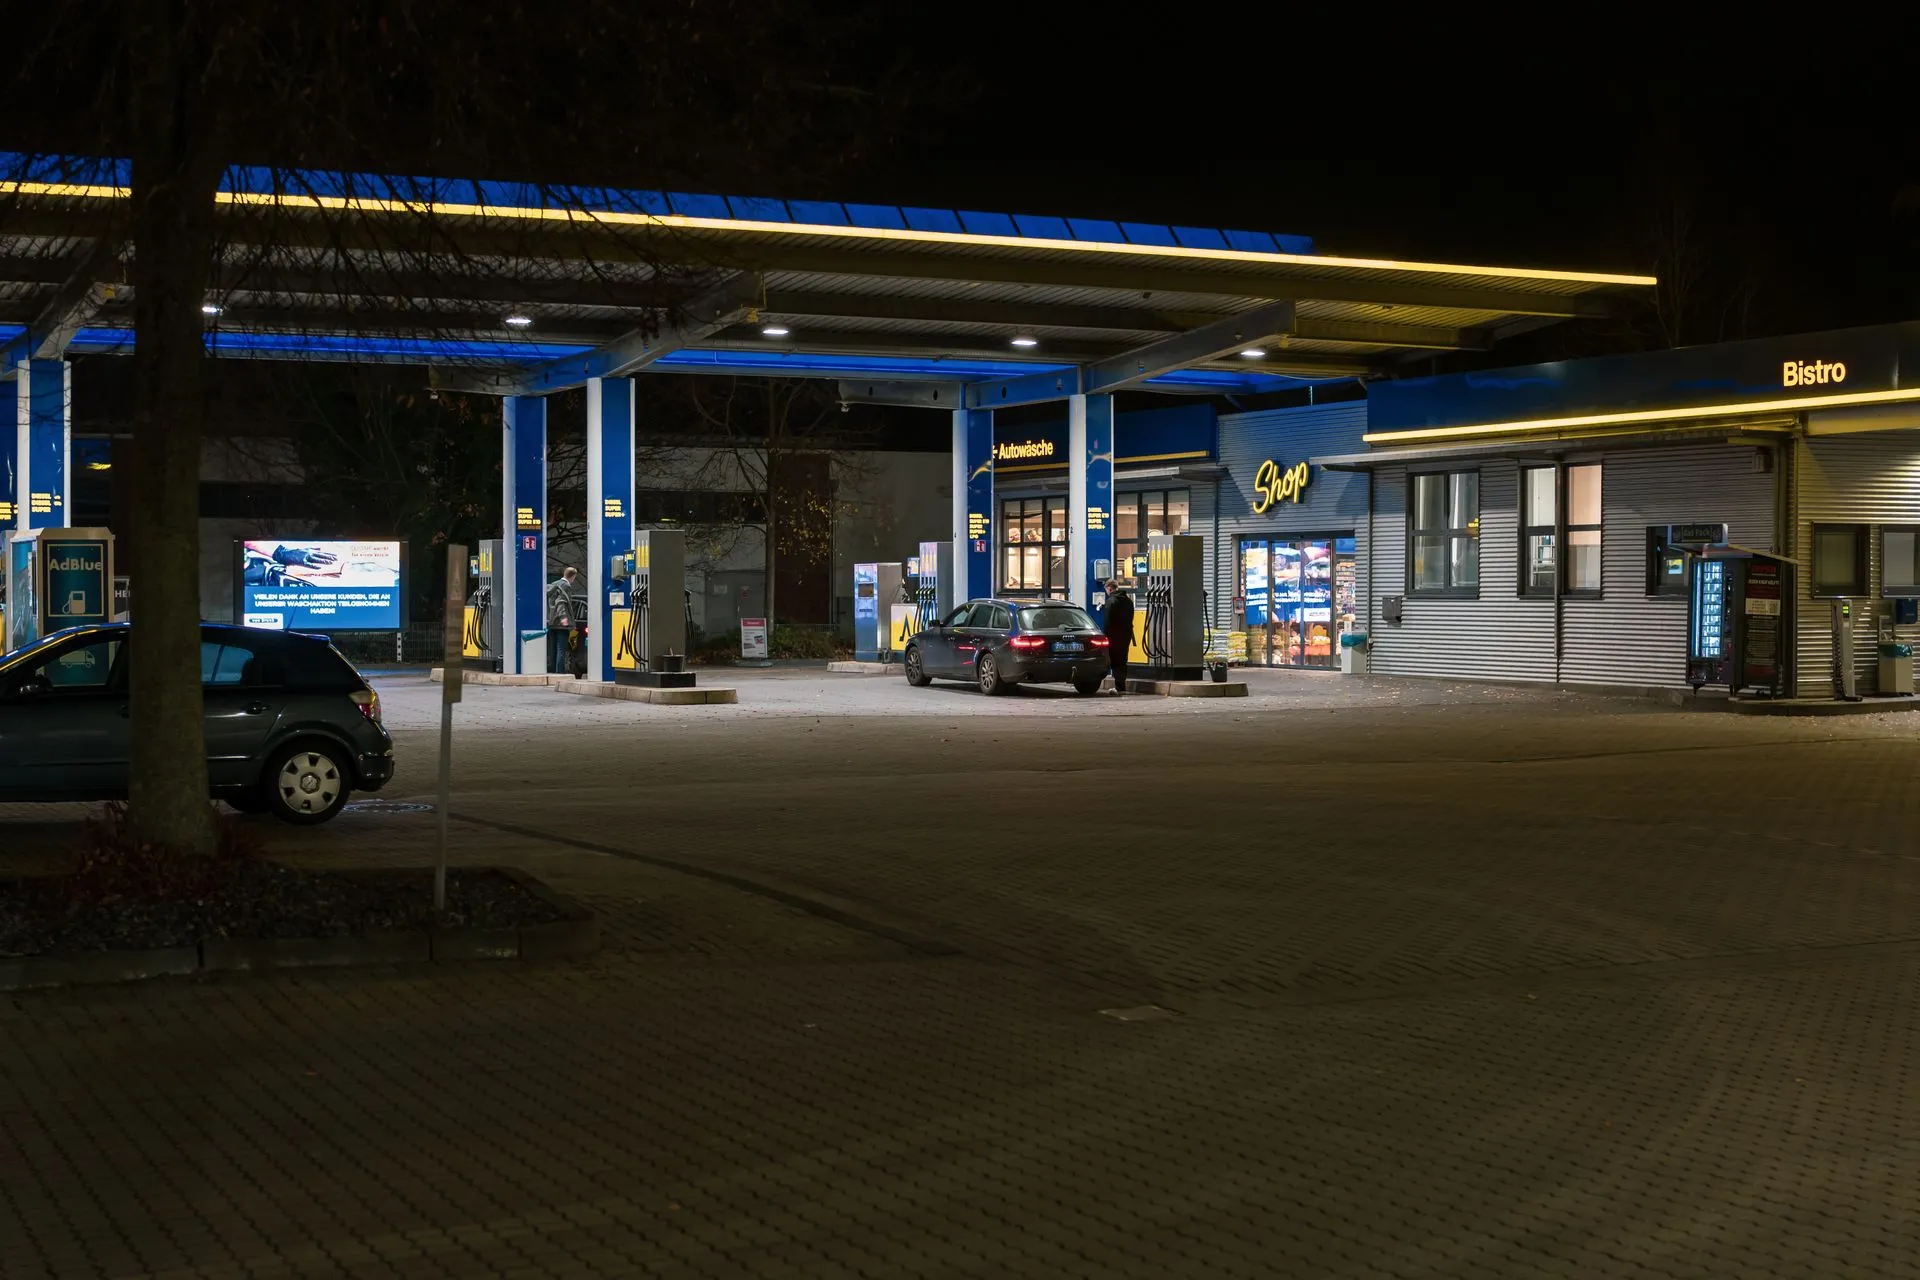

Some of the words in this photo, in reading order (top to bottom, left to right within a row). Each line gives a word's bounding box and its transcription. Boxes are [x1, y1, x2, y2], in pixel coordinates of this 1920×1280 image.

[1783, 360, 1846, 387] Bistro
[999, 439, 1053, 459] Autowäsche
[1253, 460, 1308, 514] Shop
[49, 557, 102, 570] AdBlue
[338, 593, 367, 601] KUNDEN,
